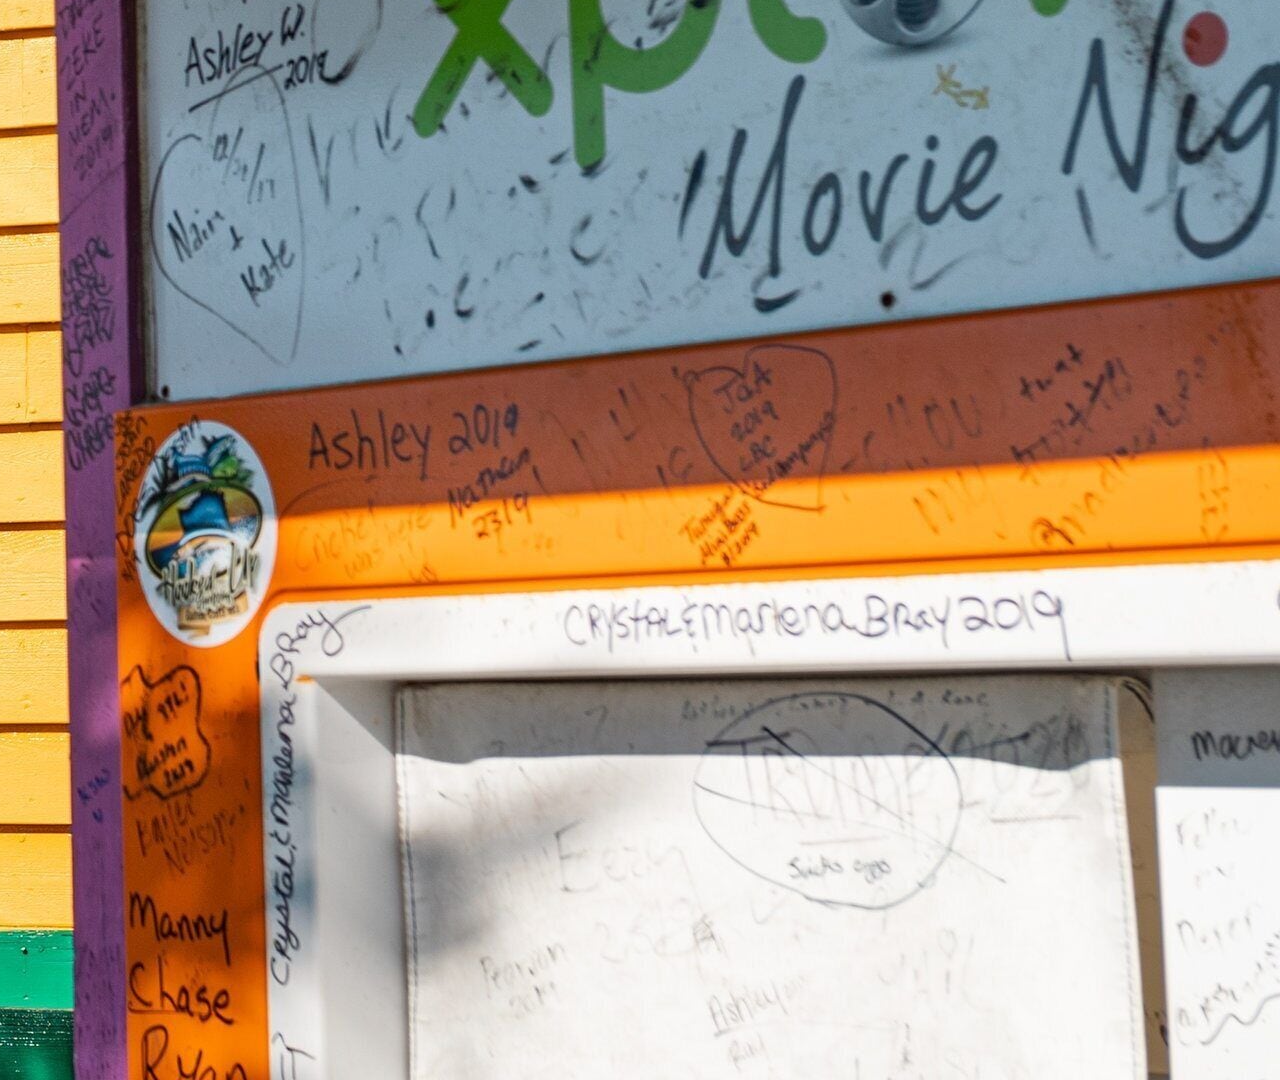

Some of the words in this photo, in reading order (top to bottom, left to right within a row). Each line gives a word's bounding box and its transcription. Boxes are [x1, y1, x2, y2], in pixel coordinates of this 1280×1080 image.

[184, 22, 274, 87] Ashley
[239, 238, 296, 309] Kate
[308, 408, 431, 482] Ashley
[958, 590, 1074, 663] 2019
[128, 891, 231, 967] Manny
[127, 954, 235, 1025] Chase
